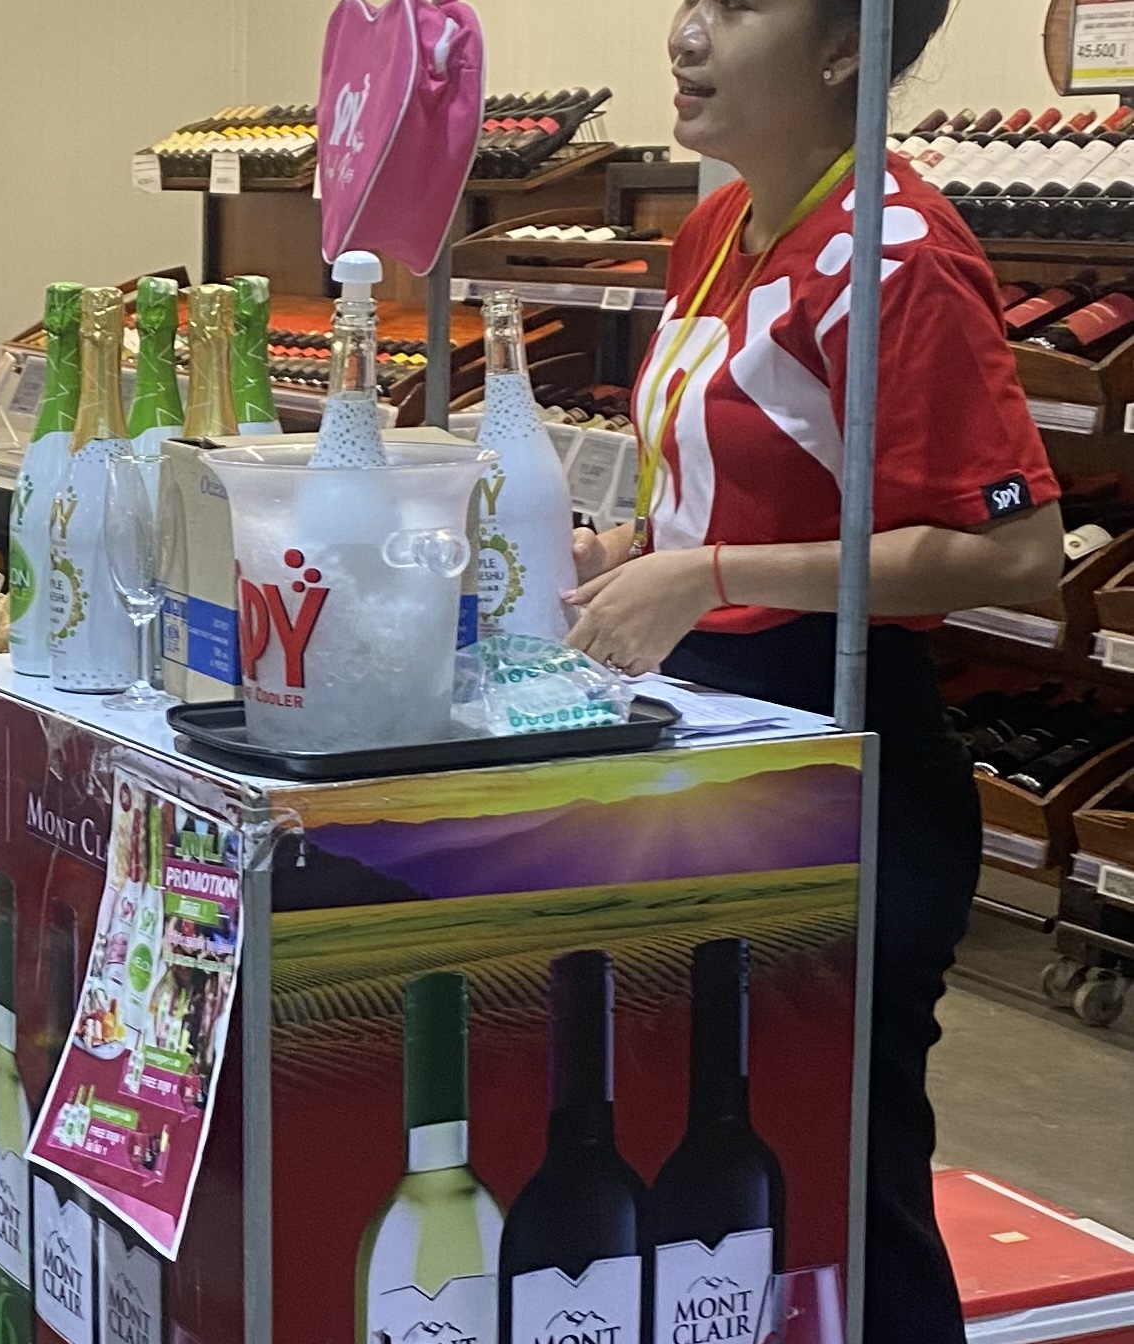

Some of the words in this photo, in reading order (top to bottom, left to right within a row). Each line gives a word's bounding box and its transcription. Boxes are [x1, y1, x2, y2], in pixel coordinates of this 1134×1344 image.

[991, 482, 1021, 510] SPY
[26, 791, 77, 846] MONT
[166, 865, 238, 899] PROMOTION
[43, 1239, 83, 1295] MONT
[42, 1268, 84, 1321] CLAIR
[109, 1282, 152, 1336] MONT
[674, 1290, 753, 1324] MONT
